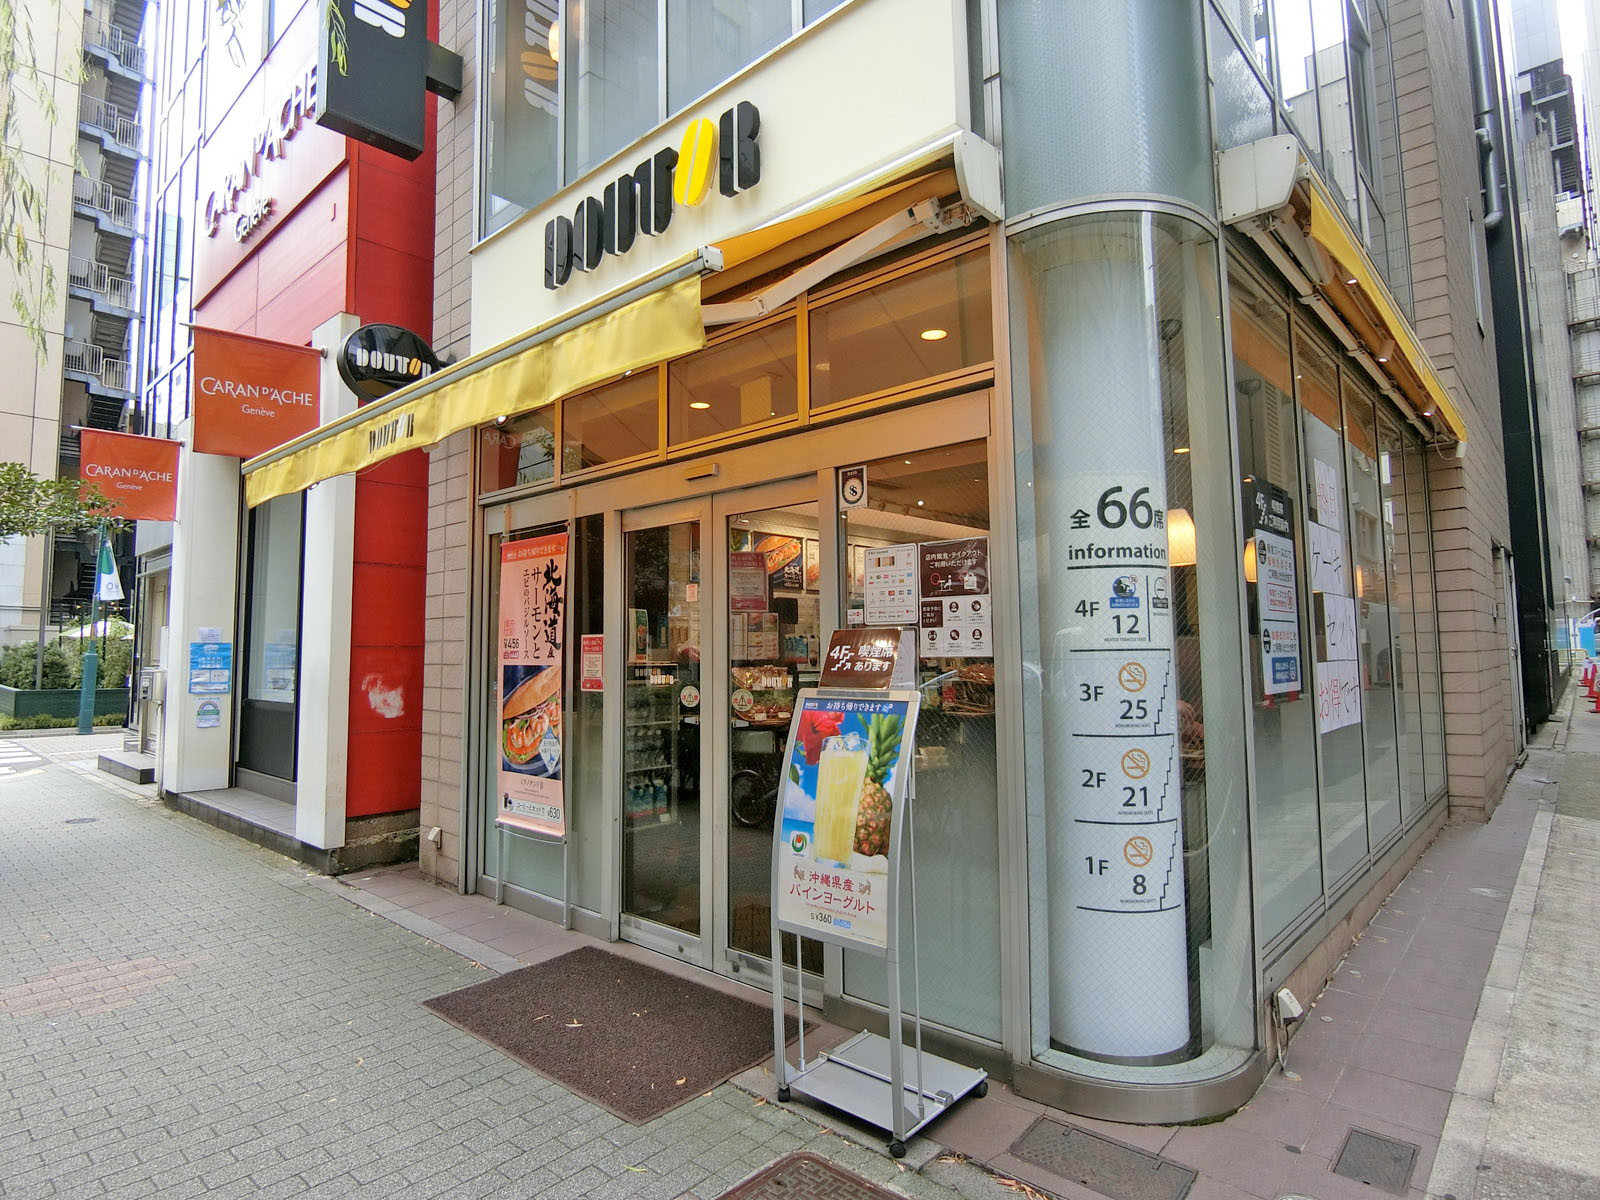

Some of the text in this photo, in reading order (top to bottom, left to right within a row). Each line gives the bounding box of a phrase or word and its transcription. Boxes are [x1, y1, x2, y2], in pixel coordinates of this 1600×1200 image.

[544, 100, 761, 290] DOUTOR
[356, 347, 433, 379] DOUTOR
[200, 376, 313, 407] CARAN D'ACHE
[241, 403, 276, 418] Genève
[85, 463, 131, 479] CARAN
[1068, 543, 1167, 561] information
[531, 566, 542, 660] サーモンと
[1074, 600, 1100, 618] 4F
[1112, 614, 1140, 634] 12
[829, 645, 852, 660] 4F
[853, 661, 892, 672] あります
[1079, 683, 1104, 701] 3F
[826, 701, 882, 712] お持ち帰りできます
[1119, 699, 1148, 720] 25
[1081, 769, 1107, 788] 2F
[1122, 787, 1149, 807] 21
[1085, 856, 1109, 876] 1F
[808, 870, 855, 893] 沖縄県産
[1132, 874, 1147, 895] 8
